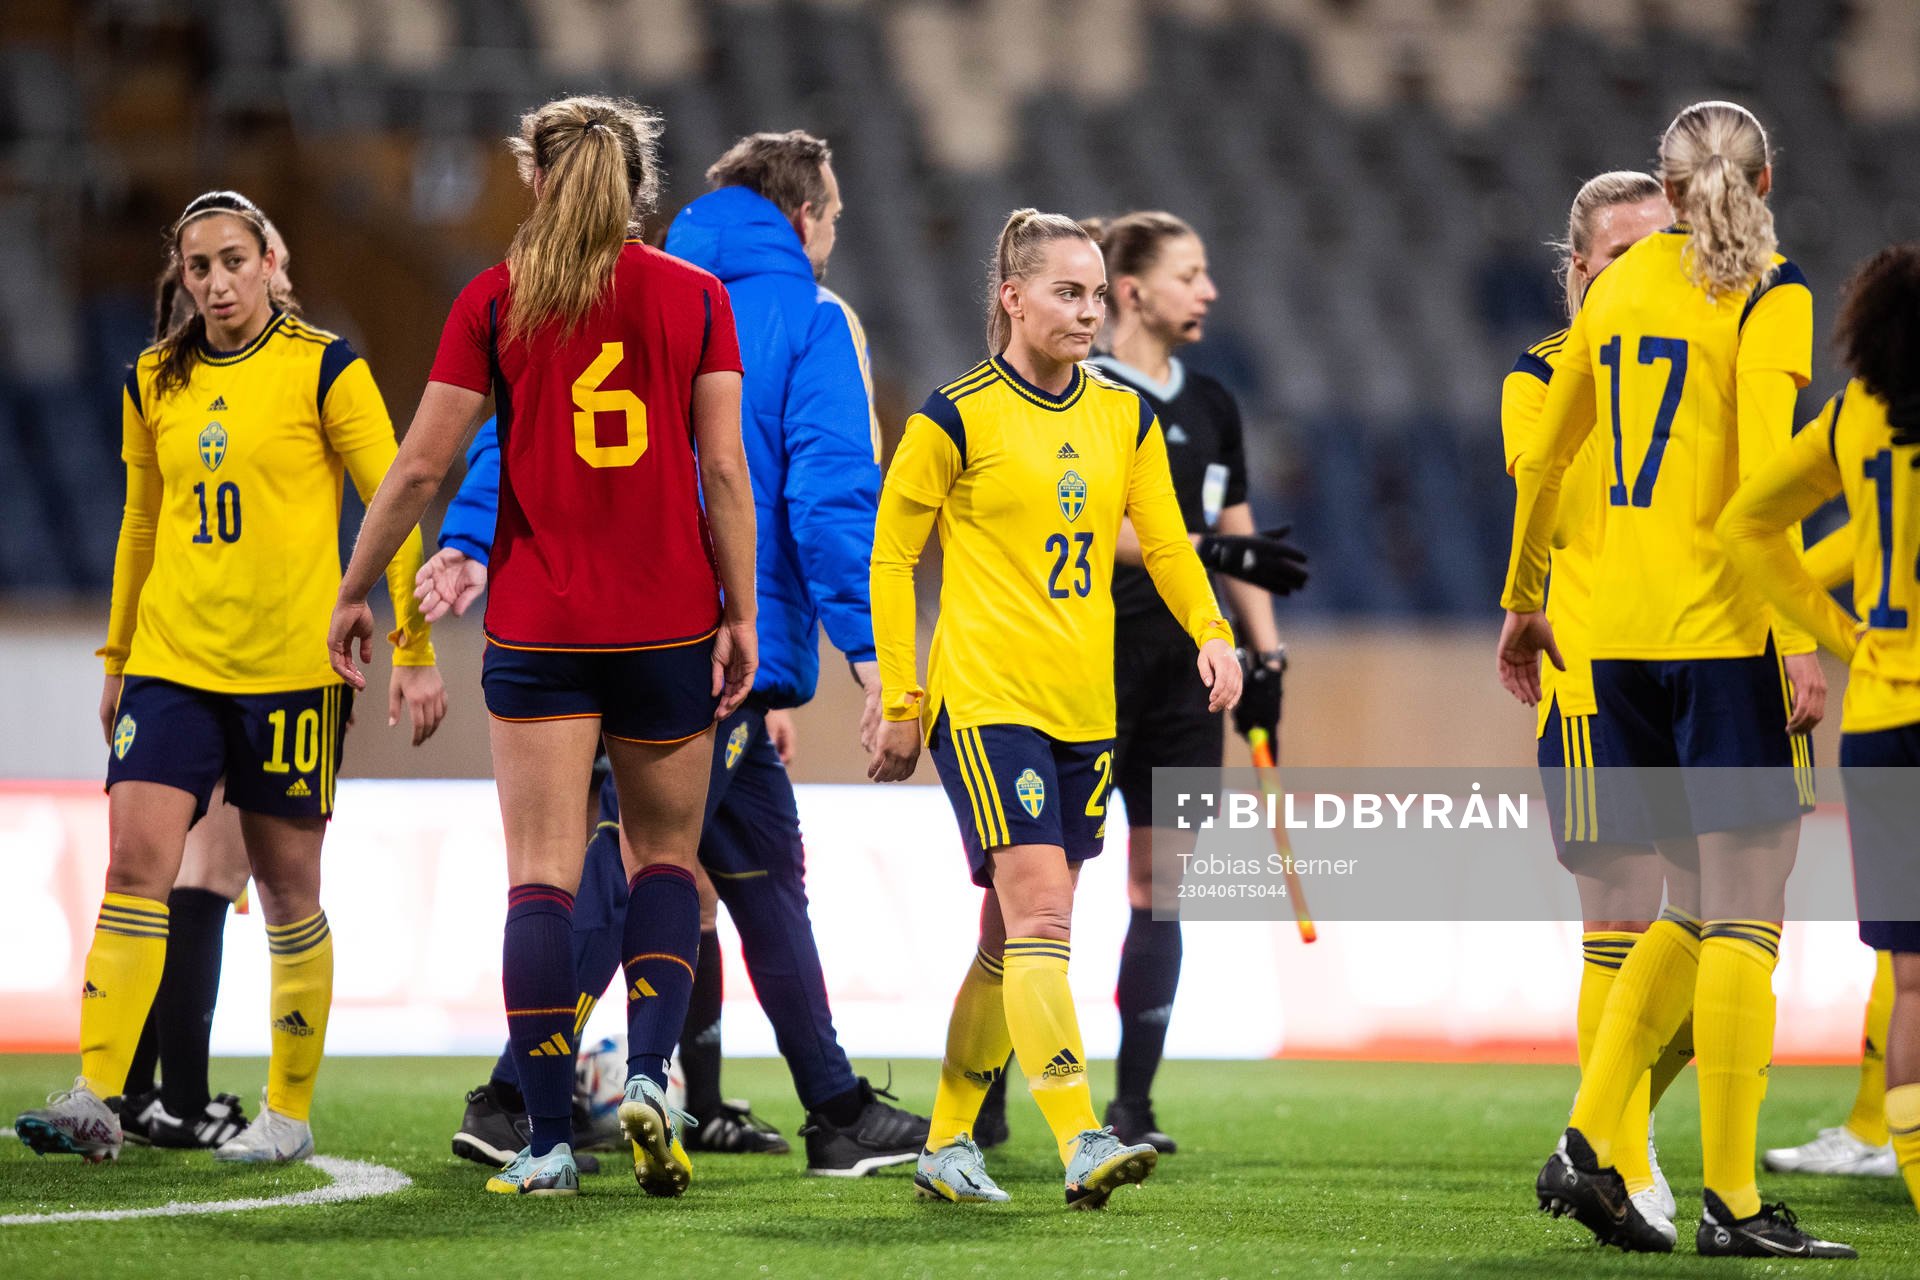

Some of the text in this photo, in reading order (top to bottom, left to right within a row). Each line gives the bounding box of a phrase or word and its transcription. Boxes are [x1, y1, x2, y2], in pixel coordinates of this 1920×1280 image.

[572, 342, 648, 468] 6
[1600, 335, 1688, 508] 17
[192, 481, 242, 544] 10
[1863, 449, 1920, 629] 1
[1045, 532, 1094, 599] 23
[263, 708, 319, 773] 10
[1085, 749, 1114, 816] 2
[1042, 1062, 1084, 1080] adidas
